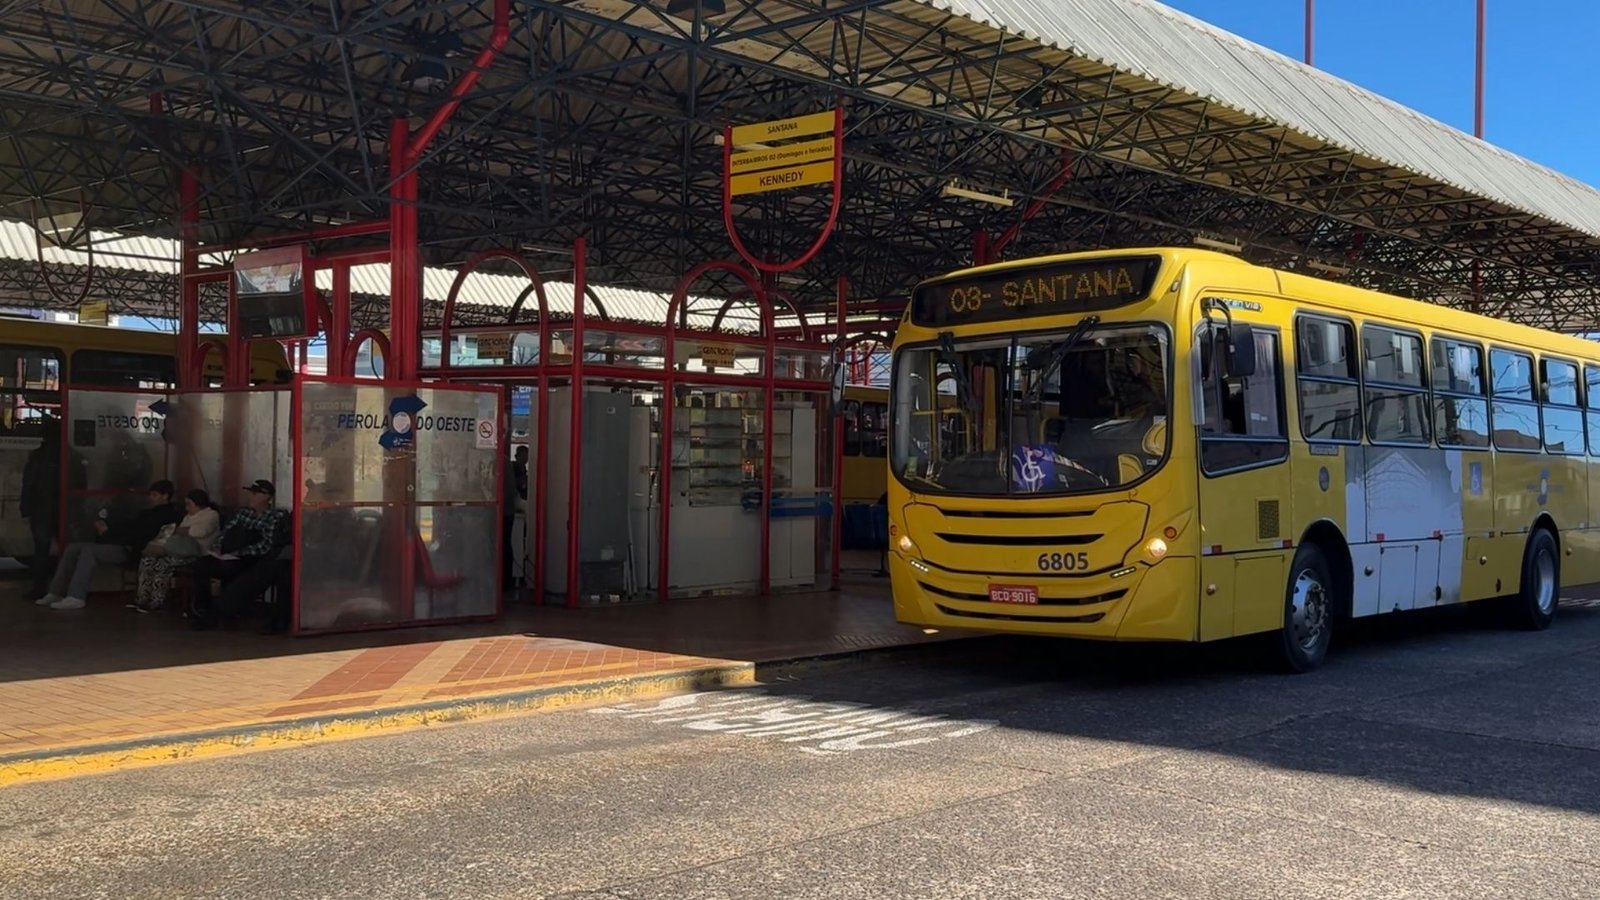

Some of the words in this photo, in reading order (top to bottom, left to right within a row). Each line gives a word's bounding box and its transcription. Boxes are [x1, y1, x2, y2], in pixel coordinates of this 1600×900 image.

[768, 122, 798, 134] SANTANA
[759, 171, 805, 187] KENNEDY
[1001, 267, 1134, 308] SANTANA
[337, 413, 389, 430] PEROLA
[415, 416, 434, 432] DO
[436, 417, 476, 433] OESTE
[1037, 552, 1089, 572] 6805
